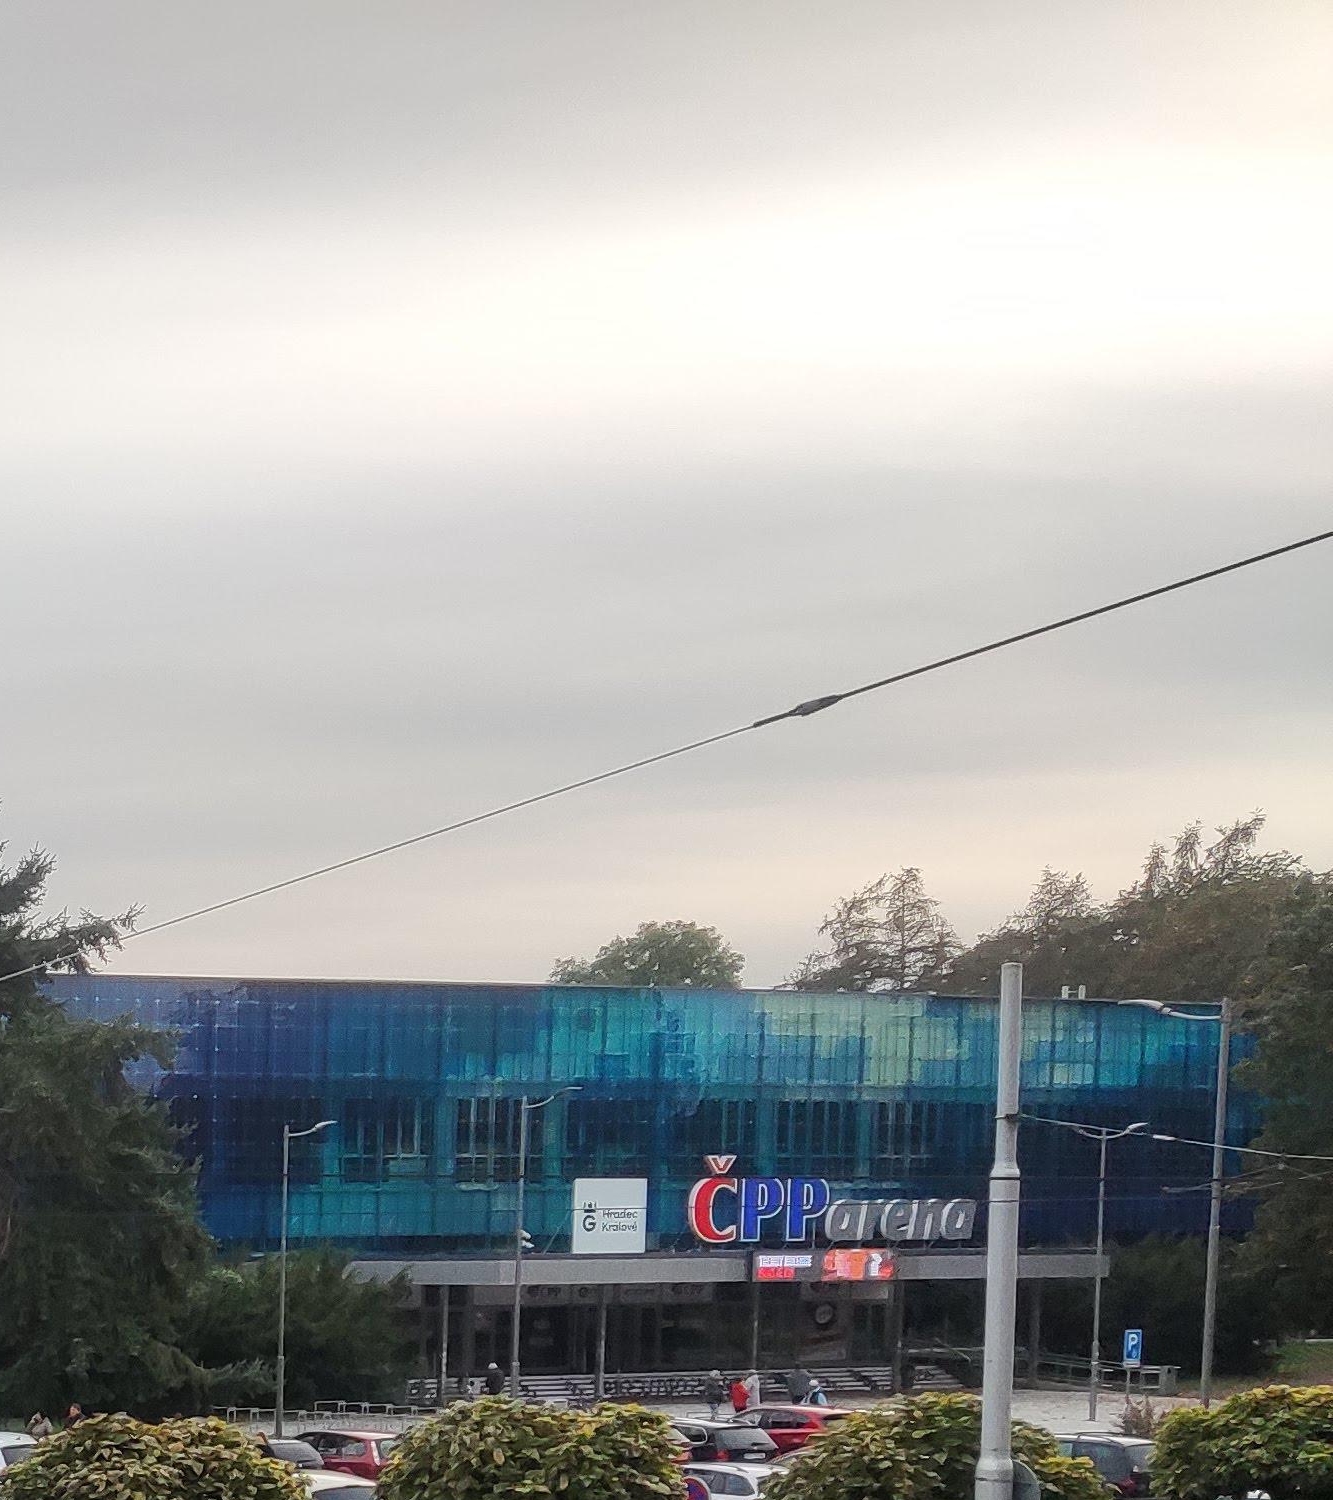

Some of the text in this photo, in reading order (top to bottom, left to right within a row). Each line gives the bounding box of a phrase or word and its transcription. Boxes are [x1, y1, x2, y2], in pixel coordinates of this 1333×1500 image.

[688, 1154, 978, 1244] ČPP arena
[601, 1207, 638, 1219] Hradec
[1127, 1333, 1139, 1352] P
